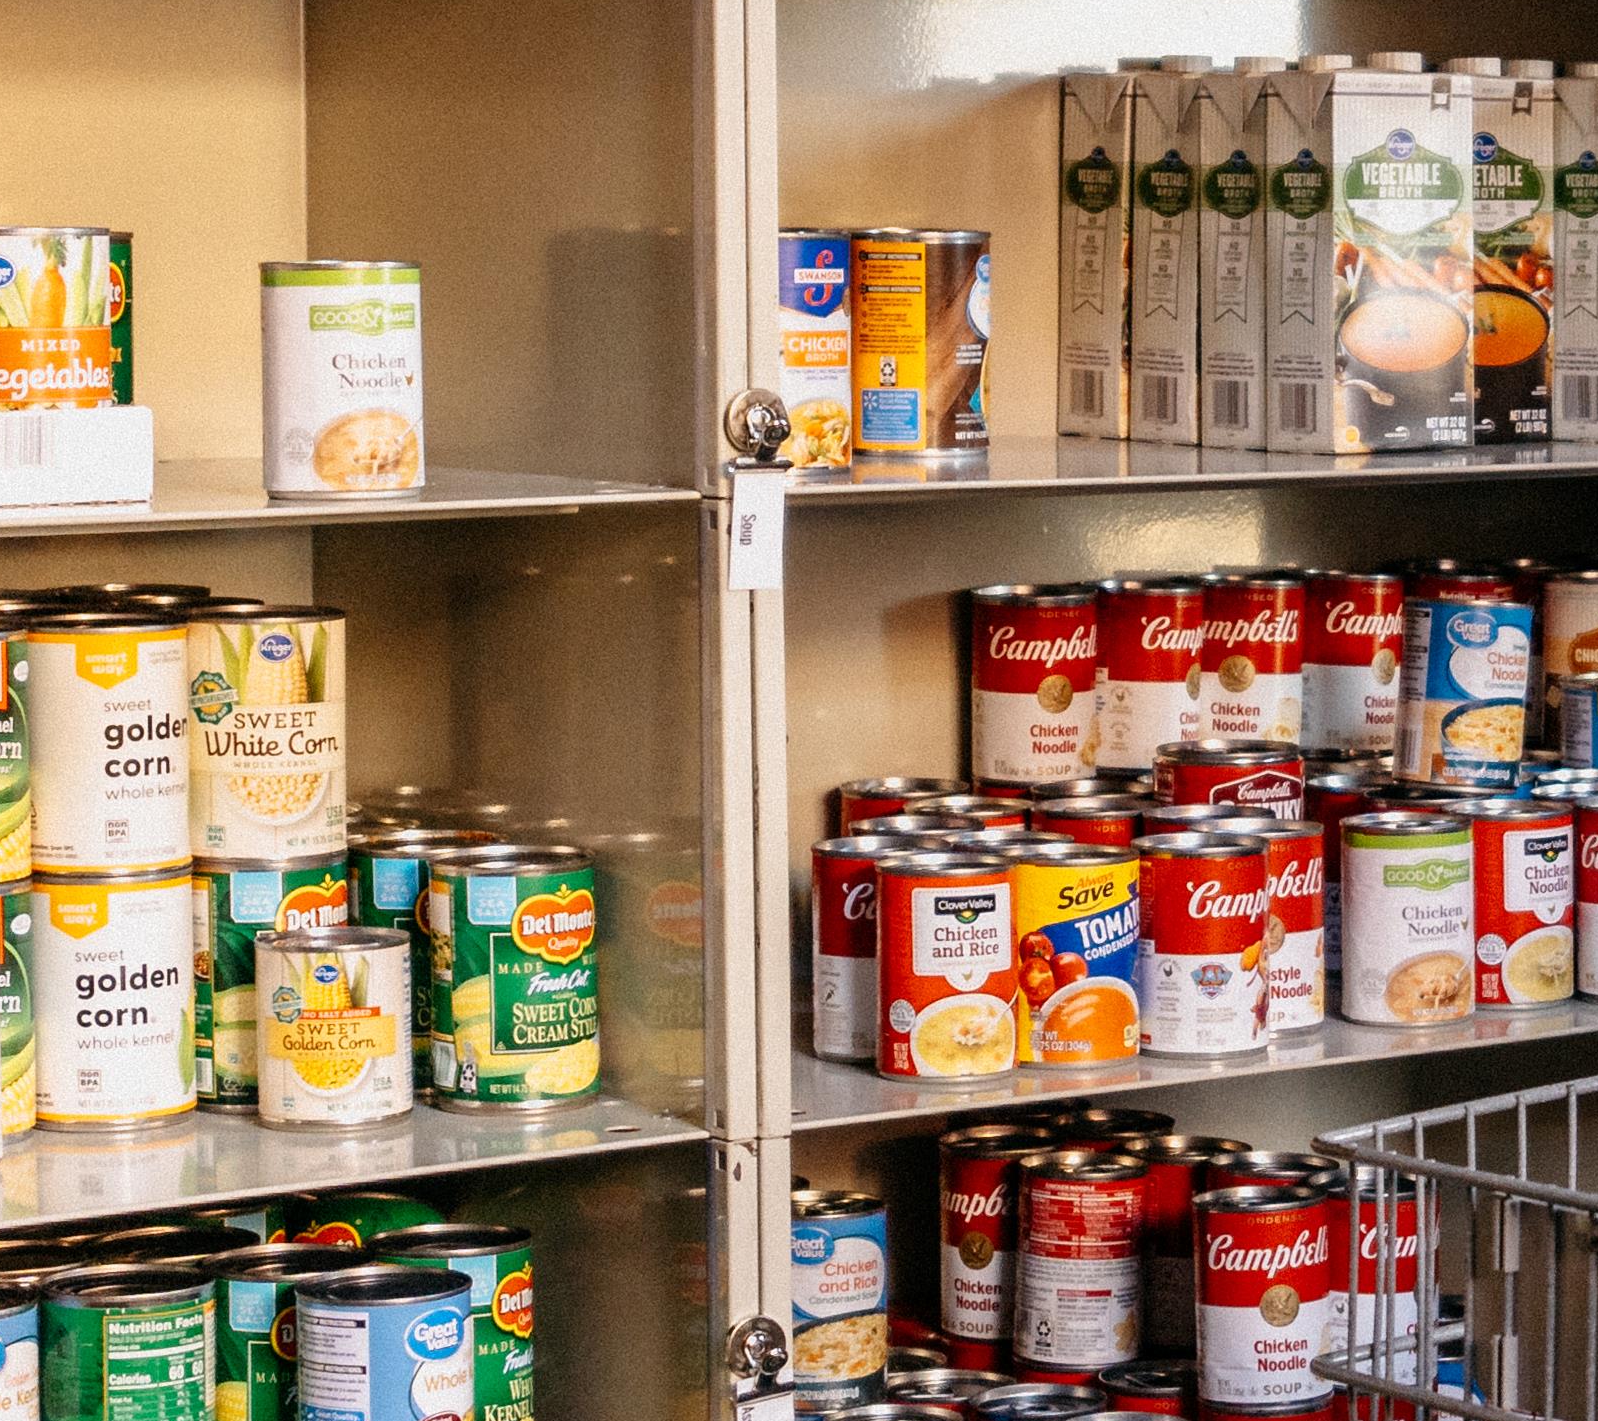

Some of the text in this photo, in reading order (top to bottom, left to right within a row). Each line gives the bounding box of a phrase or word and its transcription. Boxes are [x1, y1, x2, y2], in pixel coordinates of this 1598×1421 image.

[1361, 164, 1440, 186] VEGETABLE
[1379, 186, 1422, 197] BROTH
[799, 271, 844, 281] SWANSON
[21, 338, 82, 353] MIXED
[788, 337, 846, 351] CHICKEN
[332, 353, 405, 370] Chicken
[805, 352, 838, 362] BROTH
[339, 371, 403, 390] Noodle
[235, 711, 315, 727] SWEET
[1030, 724, 1078, 737] Chicken
[205, 731, 338, 758] White Corn
[1032, 742, 1076, 754] Noodle
[1524, 864, 1569, 880] Chicken
[1529, 879, 1568, 894] Noodle
[1058, 881, 1114, 908] Save
[1402, 905, 1464, 919] Chicken
[933, 926, 997, 939] Chicken
[1407, 920, 1460, 935] Noodle
[76, 950, 124, 962] sweet
[932, 941, 999, 957] and Rice
[76, 965, 178, 998] golden
[297, 1023, 362, 1035] SWEET
[76, 1031, 175, 1048] whole kernel
[283, 1036, 374, 1051] Golden Corn
[824, 1258, 877, 1276] Chicken
[819, 1275, 877, 1294] and Rice
[1254, 1339, 1308, 1353] Chicken
[1257, 1354, 1306, 1372] Noodle
[1263, 1382, 1301, 1396] SOUP
